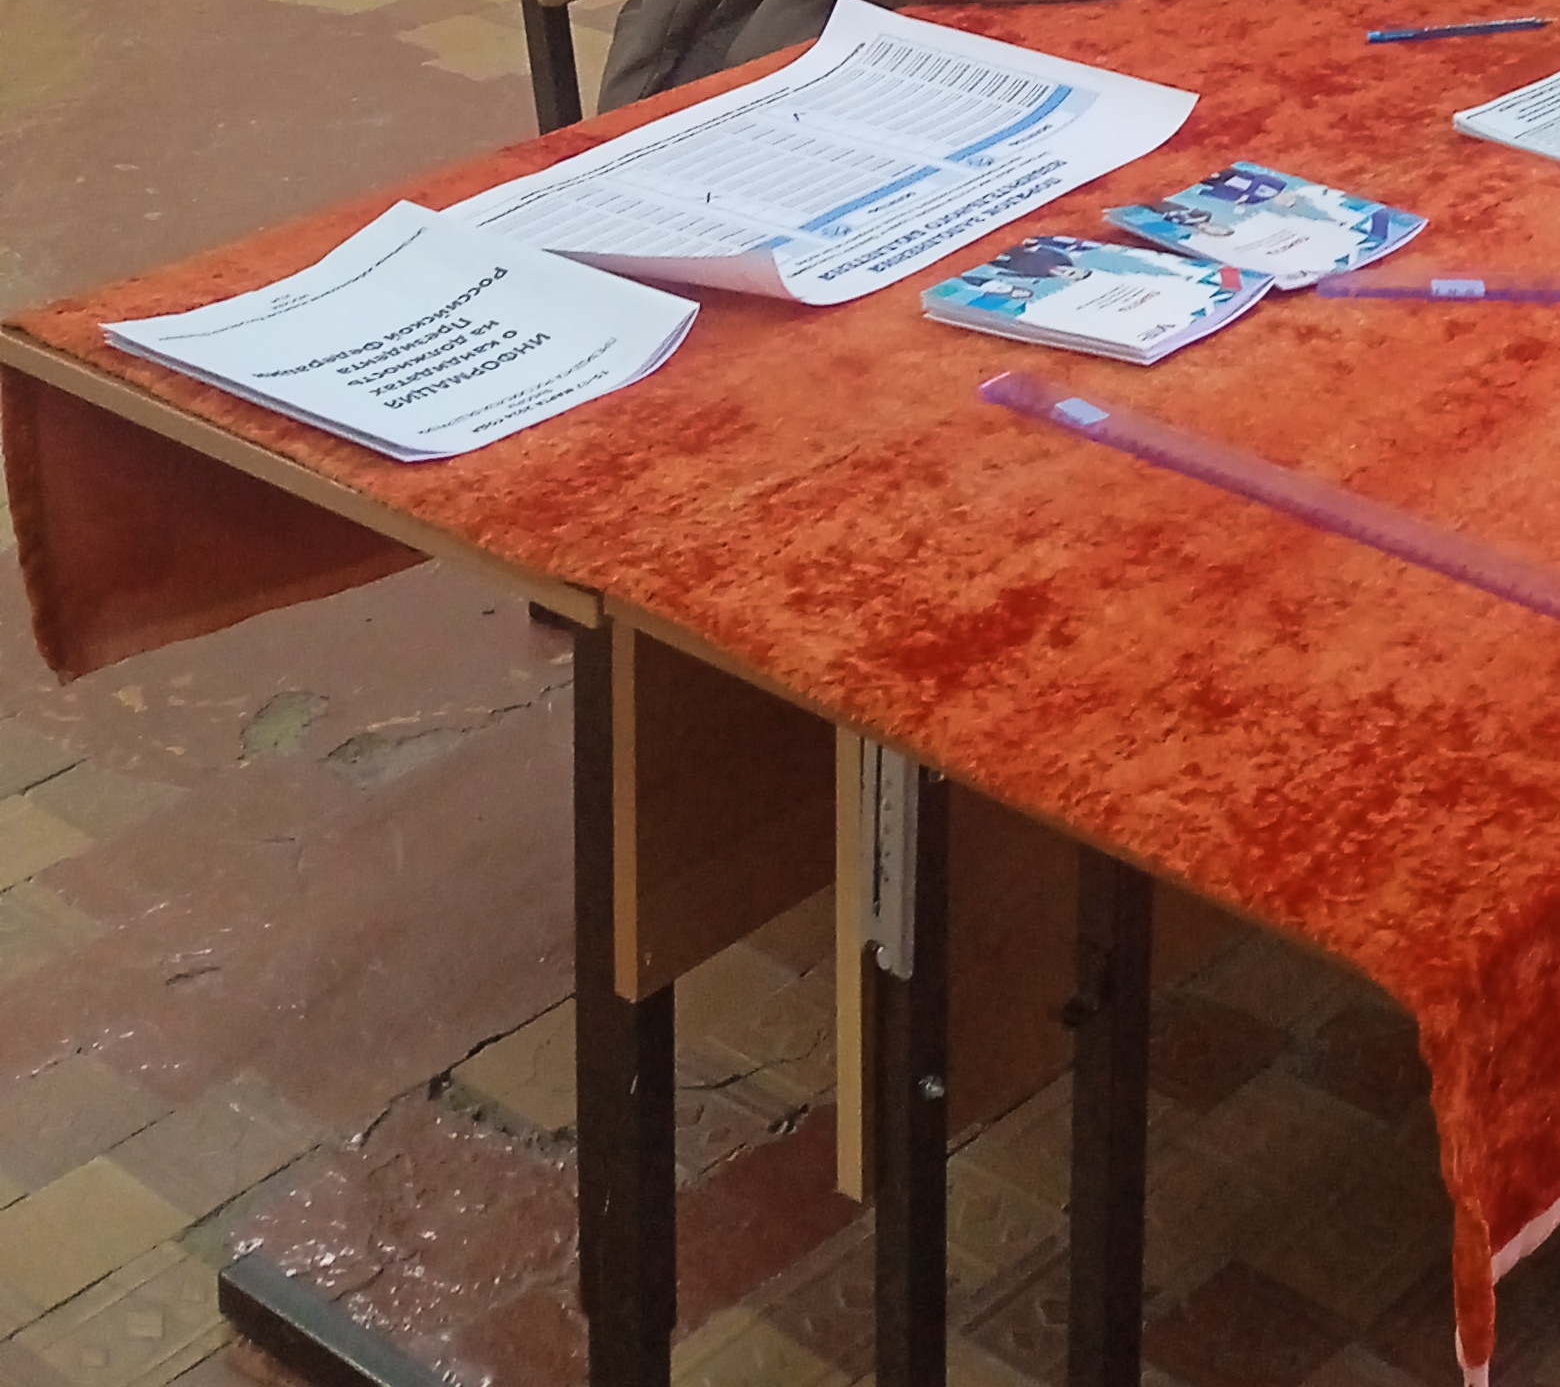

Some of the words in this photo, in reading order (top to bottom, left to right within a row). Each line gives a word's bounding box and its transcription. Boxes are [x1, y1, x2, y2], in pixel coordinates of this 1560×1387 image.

[384, 266, 508, 342] Российской
[470, 319, 500, 336] на
[336, 317, 473, 375] Президента
[347, 334, 468, 386] должность
[502, 329, 518, 340] о
[369, 339, 501, 397] кандидатах
[384, 331, 551, 410] ИНФОРМАЦИЯ
